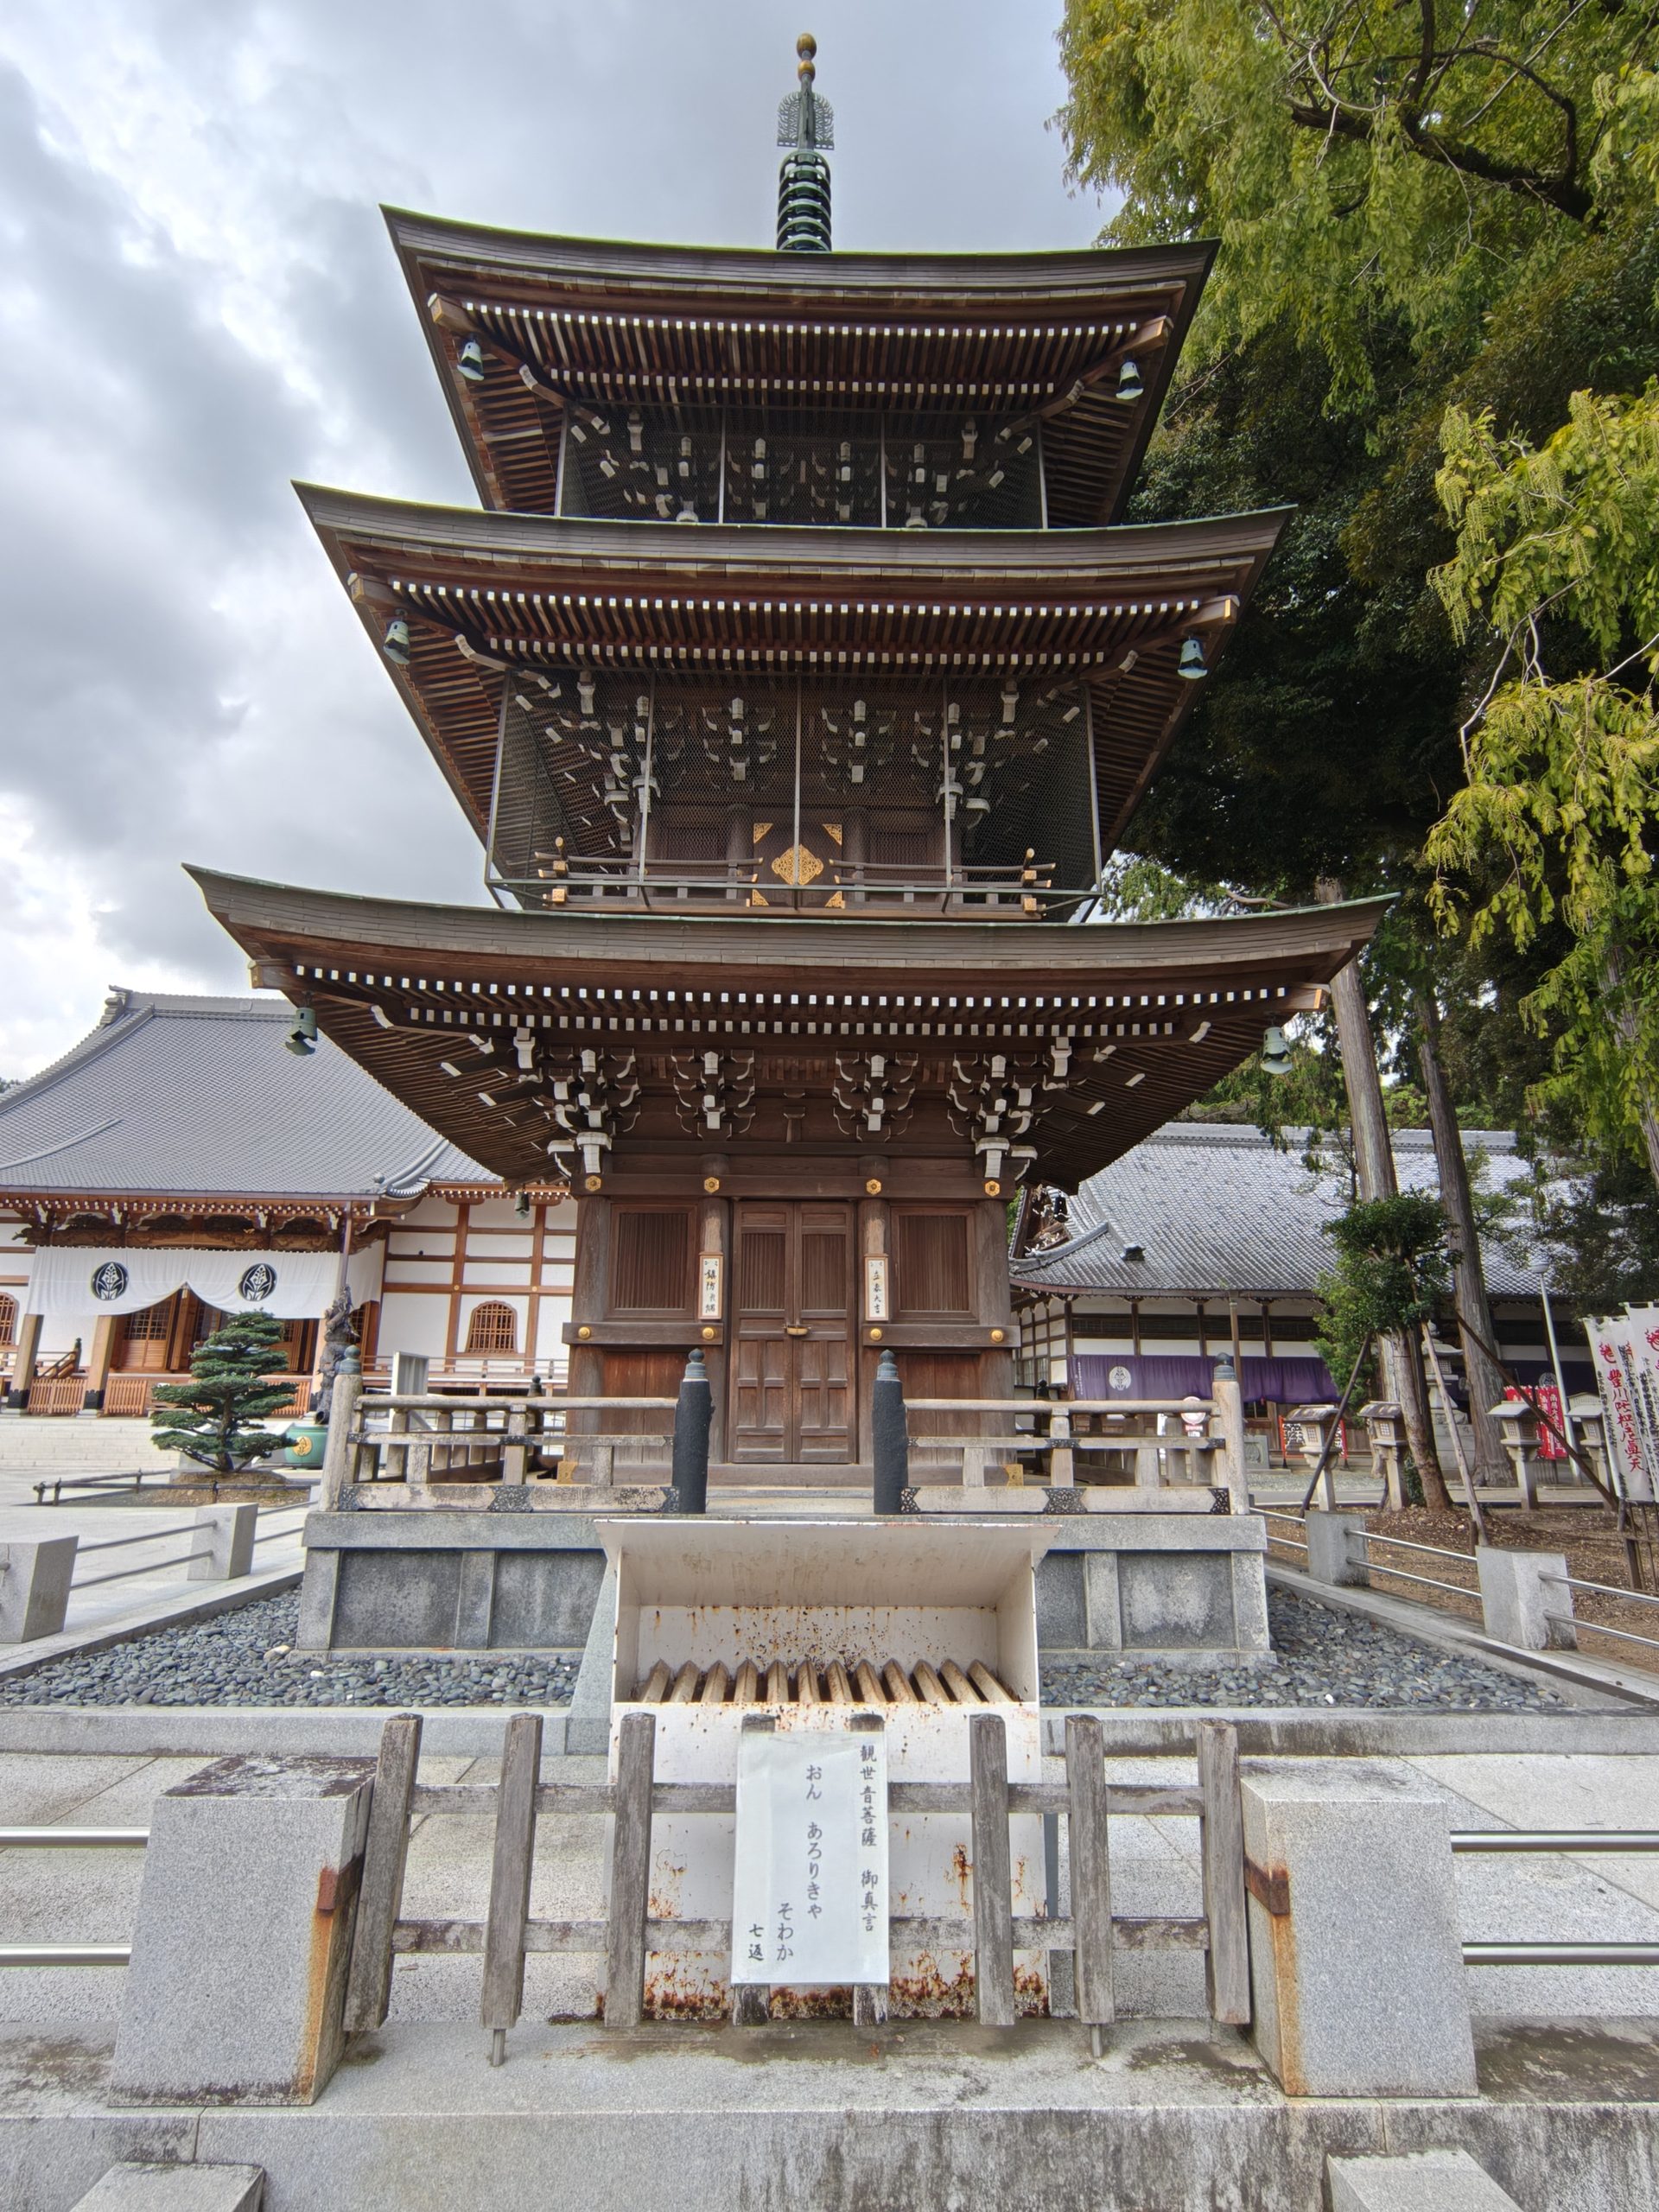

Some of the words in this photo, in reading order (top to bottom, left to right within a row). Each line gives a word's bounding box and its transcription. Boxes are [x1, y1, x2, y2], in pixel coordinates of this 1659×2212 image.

[806, 1764, 823, 1801] おん
[860, 1745, 877, 1847] 観世音菩薩
[806, 1821, 823, 1920] あろりきゃ
[861, 1870, 878, 1932] 御真言
[747, 1924, 765, 1961] 七返
[777, 1903, 794, 1961] そわか
